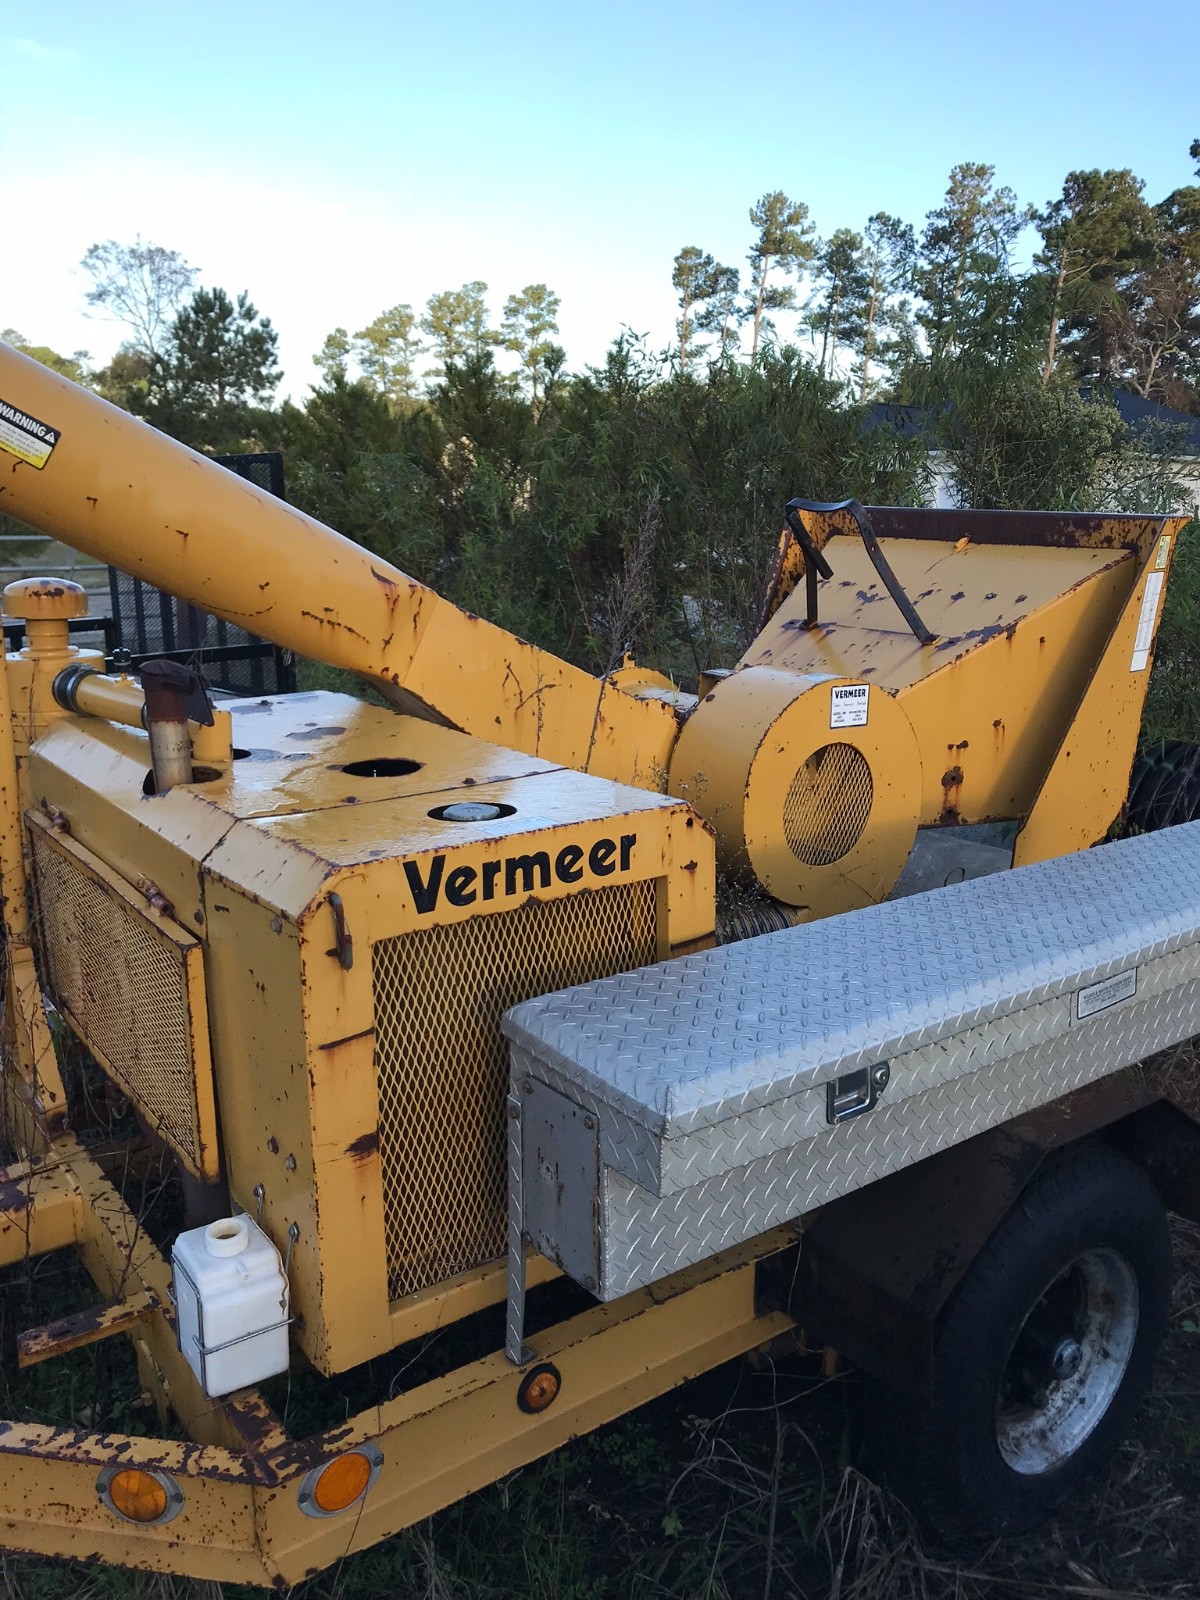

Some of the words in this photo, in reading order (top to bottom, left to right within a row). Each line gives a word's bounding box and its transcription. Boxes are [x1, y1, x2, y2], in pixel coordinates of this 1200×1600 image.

[0, 403, 47, 437] WARNING
[835, 688, 866, 699] VERMEER
[403, 833, 637, 914] Vermeer
